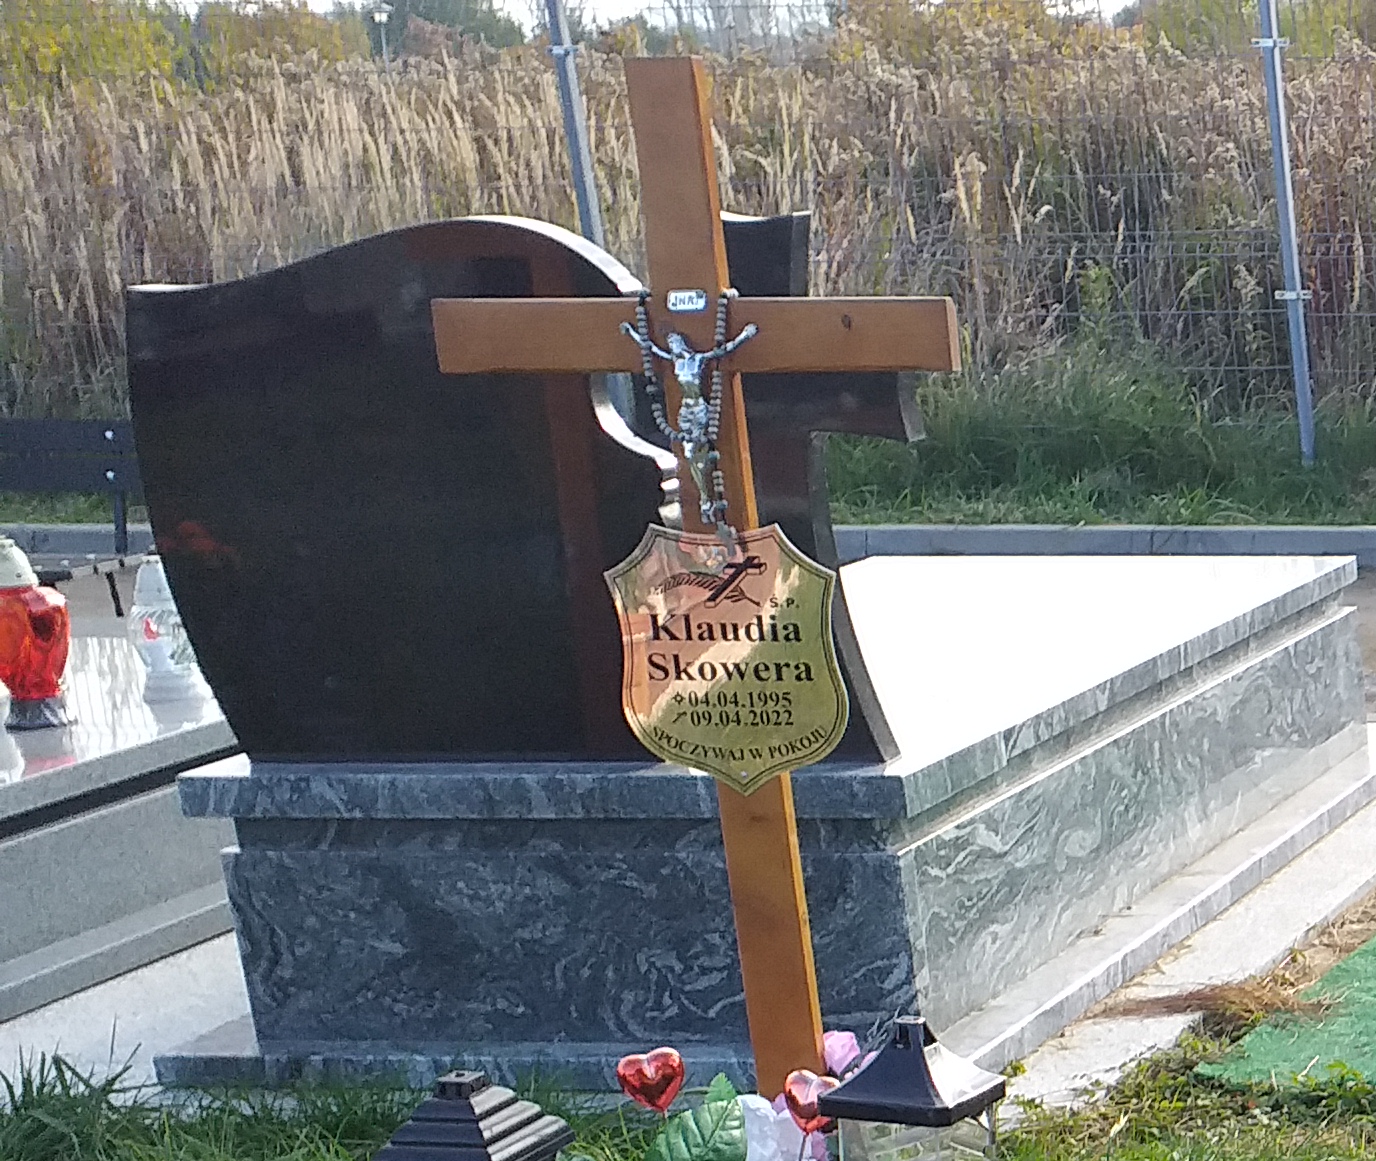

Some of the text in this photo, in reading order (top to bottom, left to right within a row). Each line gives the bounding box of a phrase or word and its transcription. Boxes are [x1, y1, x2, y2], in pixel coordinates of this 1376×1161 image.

[650, 613, 802, 643] Klaudia
[647, 652, 815, 682] Skowera
[688, 690, 792, 709] 04.04.1995
[690, 709, 794, 727] 09.04.2022
[652, 725, 828, 762] SPOCZYWAJ W POKOJU
